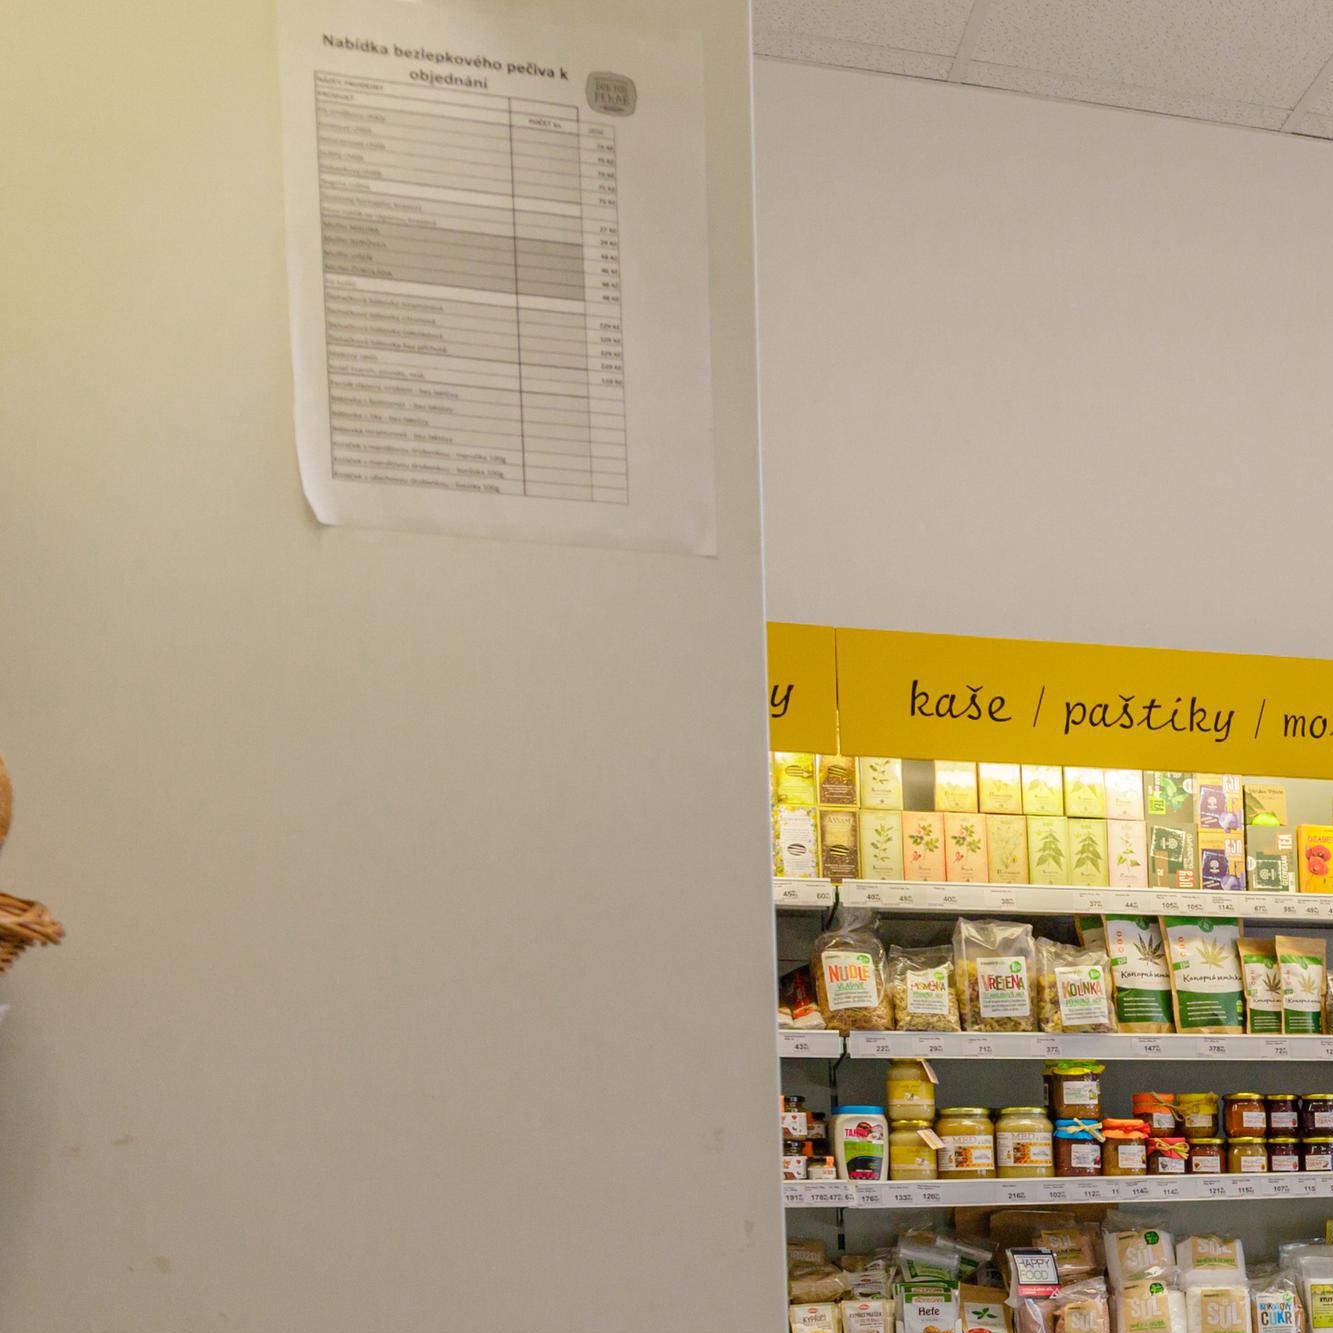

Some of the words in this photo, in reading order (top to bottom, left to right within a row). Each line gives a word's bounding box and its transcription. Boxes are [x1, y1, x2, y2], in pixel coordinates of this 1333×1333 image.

[322, 34, 388, 56] Nabídka
[393, 43, 502, 71] bezlepkového
[507, 61, 555, 79] pečiva
[560, 67, 569, 81] k
[409, 69, 488, 90] objednání
[910, 679, 1013, 723] kaše
[1064, 696, 1236, 742] paštiky
[1278, 833, 1293, 850] TEA
[828, 963, 870, 983] NUDLE
[1019, 1258, 1050, 1269] HAPPY
[1020, 1269, 1049, 1281] FOOD
[918, 1306, 940, 1317] Hefe
[1261, 1311, 1293, 1326] CUKR
